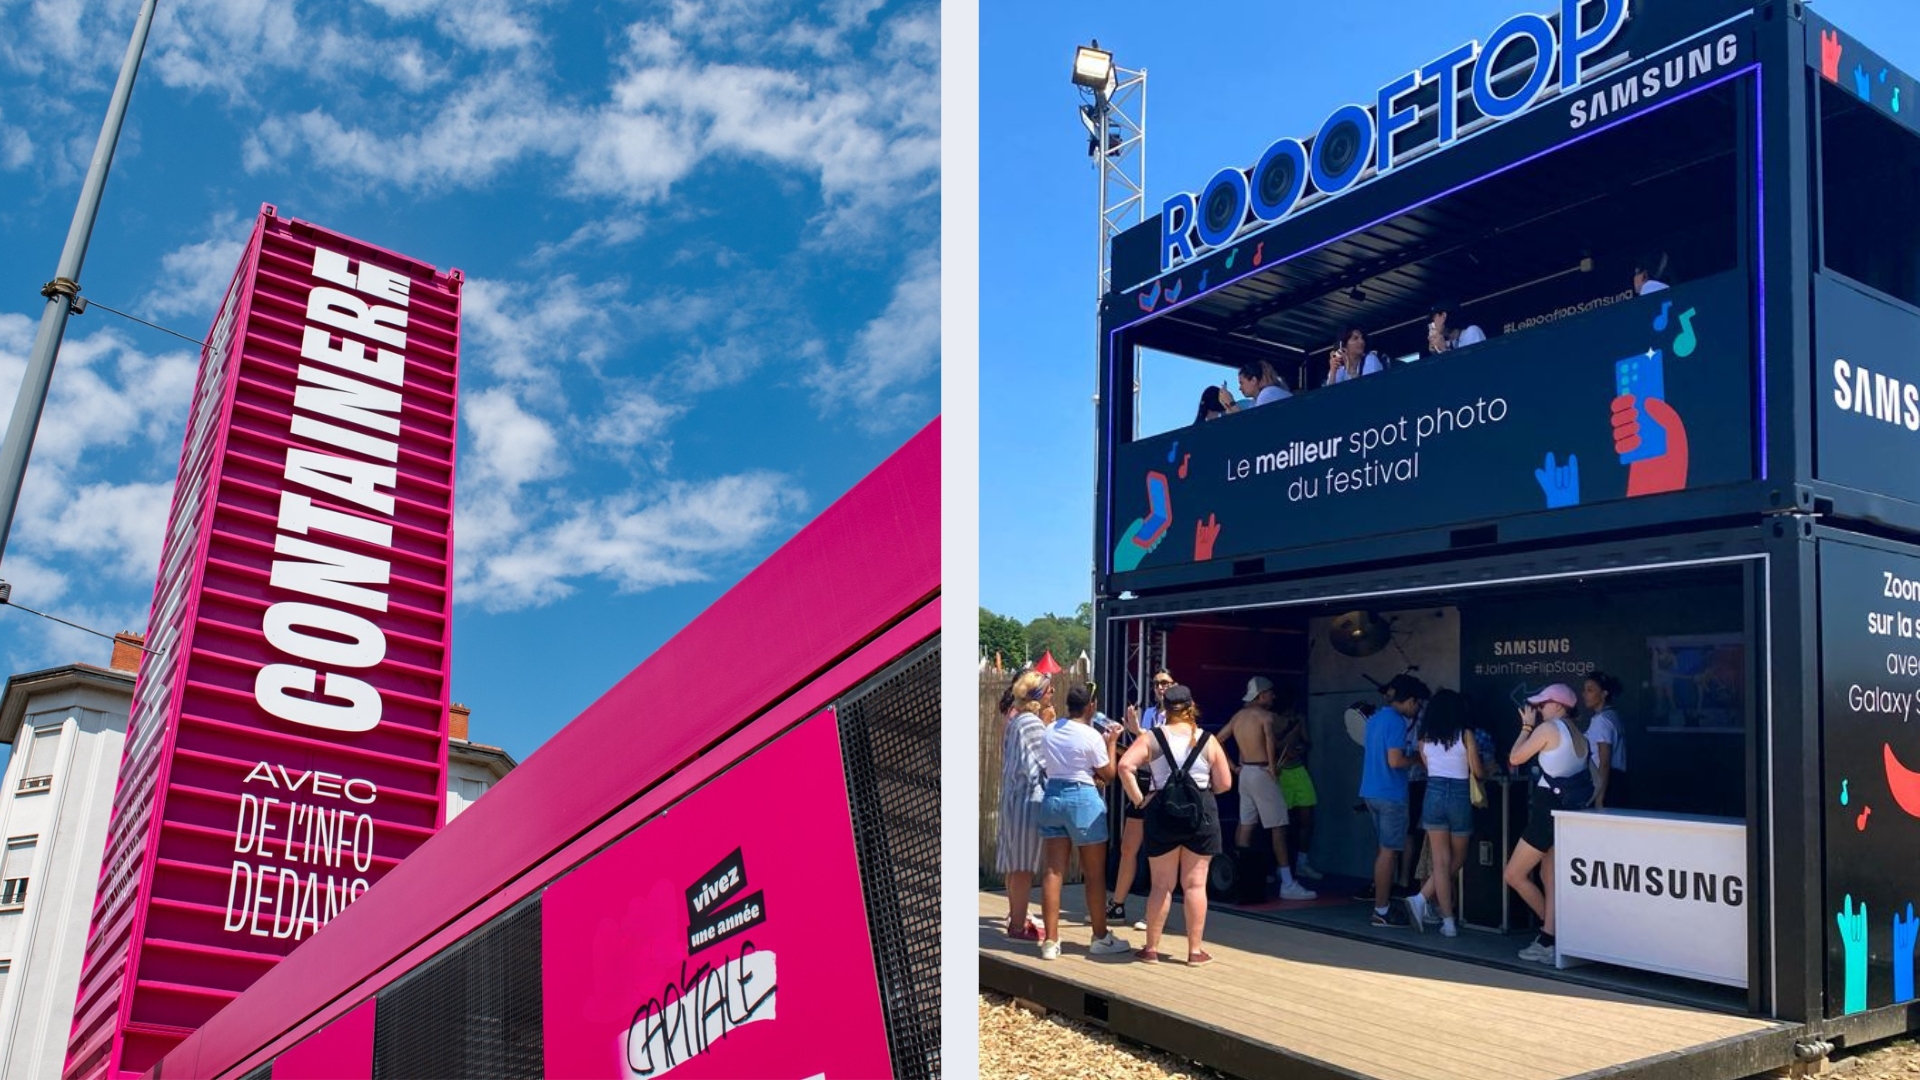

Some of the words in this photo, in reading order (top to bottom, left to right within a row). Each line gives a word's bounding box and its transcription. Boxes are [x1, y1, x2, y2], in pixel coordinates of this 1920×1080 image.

[1570, 34, 1737, 129] SAMSUNG
[1161, 0, 1629, 272] ROOOFTOP
[1834, 358, 1920, 431] SAMS
[1227, 459, 1250, 482] Le
[1256, 436, 1343, 475] meilleur
[1349, 416, 1408, 459] spot
[1416, 397, 1508, 447] photo
[1288, 477, 1319, 502] du
[1326, 452, 1419, 495] festival
[255, 286, 409, 732] CONTAINER
[1493, 638, 1571, 656] SAMSUNG
[1868, 612, 1894, 636] sur
[1898, 611, 1912, 639] la
[1475, 660, 1596, 676] #JoinTheFlipStage
[1886, 652, 1920, 677] ave
[1848, 684, 1912, 723] Galaxy
[243, 761, 378, 805] AVEC
[234, 793, 280, 858] DE
[284, 801, 374, 873] L'INFO
[693, 865, 740, 913] vivez
[1570, 857, 1744, 907] SAMSUNG
[691, 921, 717, 948] une
[717, 904, 760, 934] année
[627, 940, 778, 1076] CAPITALE
